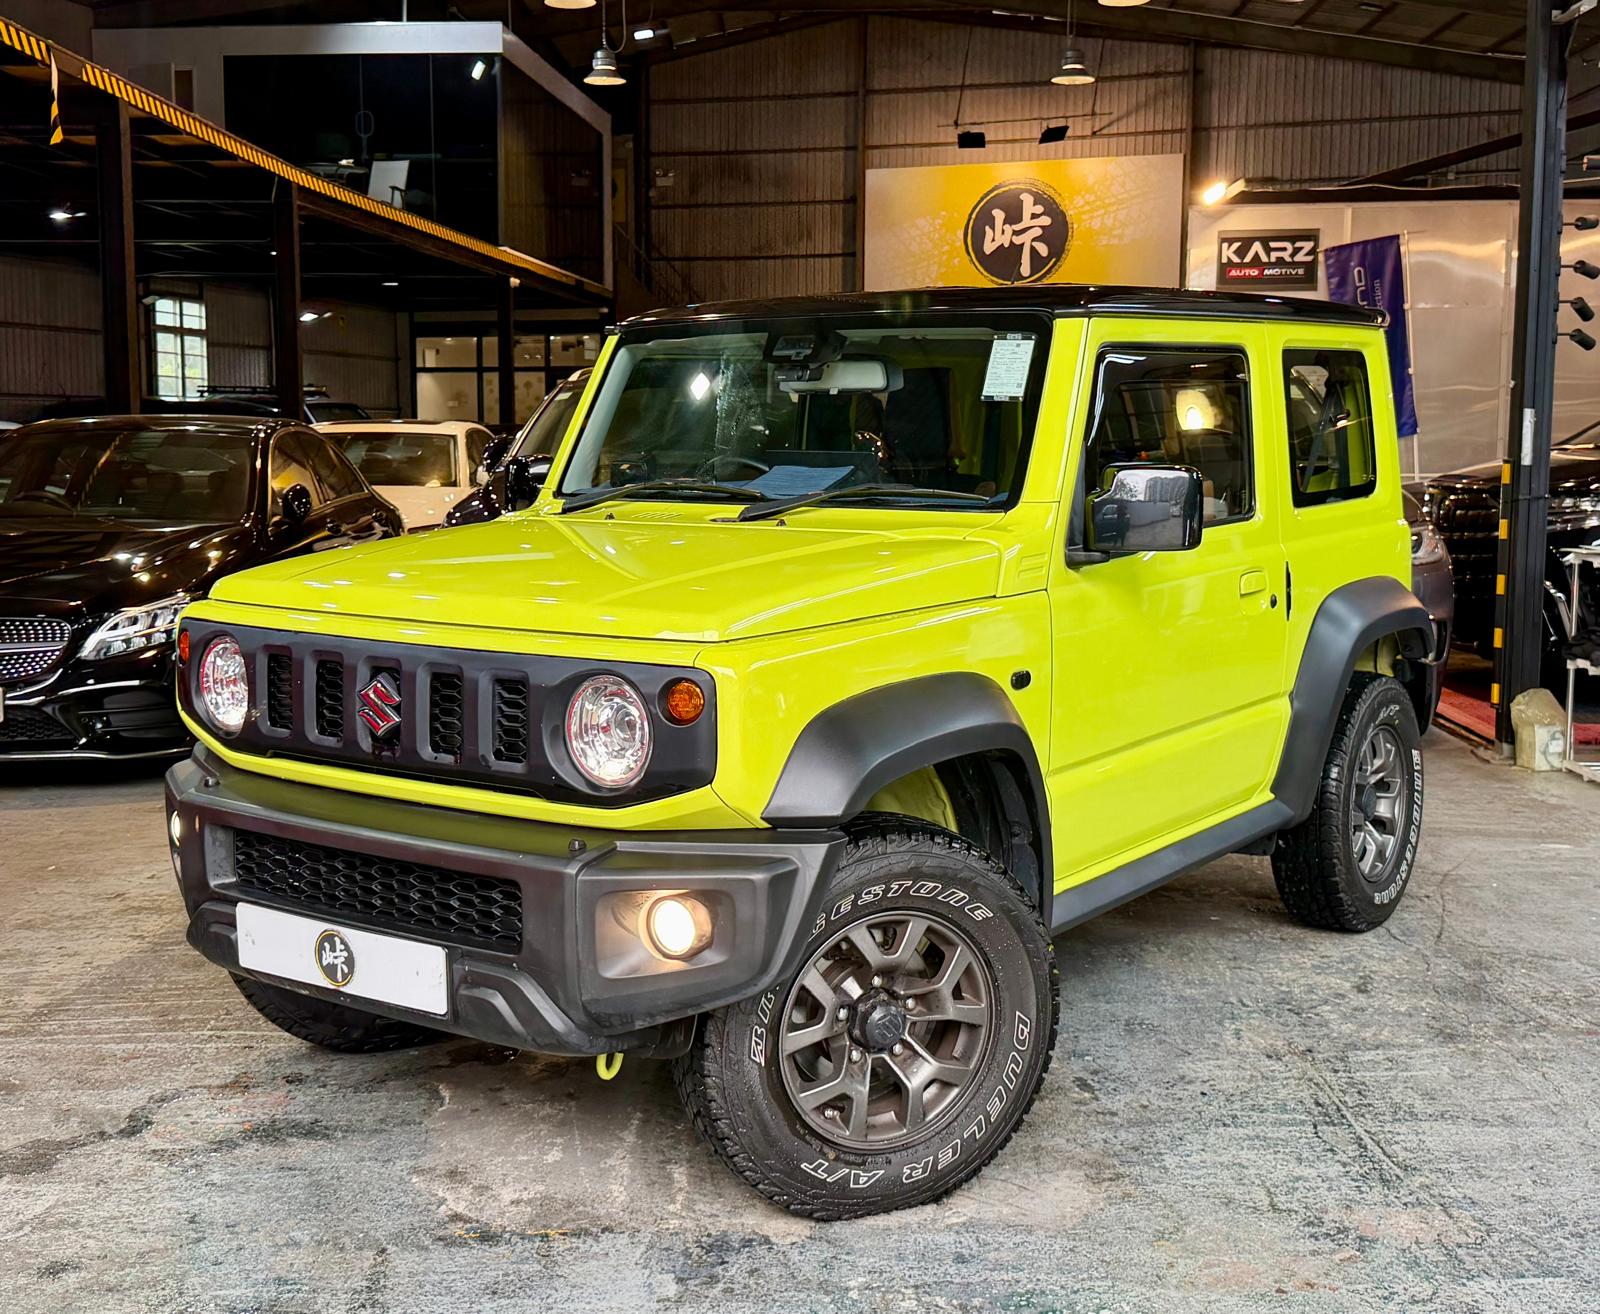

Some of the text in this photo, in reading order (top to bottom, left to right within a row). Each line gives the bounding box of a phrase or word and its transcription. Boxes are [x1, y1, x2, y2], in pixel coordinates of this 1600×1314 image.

[983, 192, 1052, 277] 峠
[1221, 240, 1315, 263] KARZ
[1228, 268, 1305, 276] AUTO MOTIVE
[321, 936, 349, 983] 峠
[801, 1010, 1032, 1188] DUELER A/T
